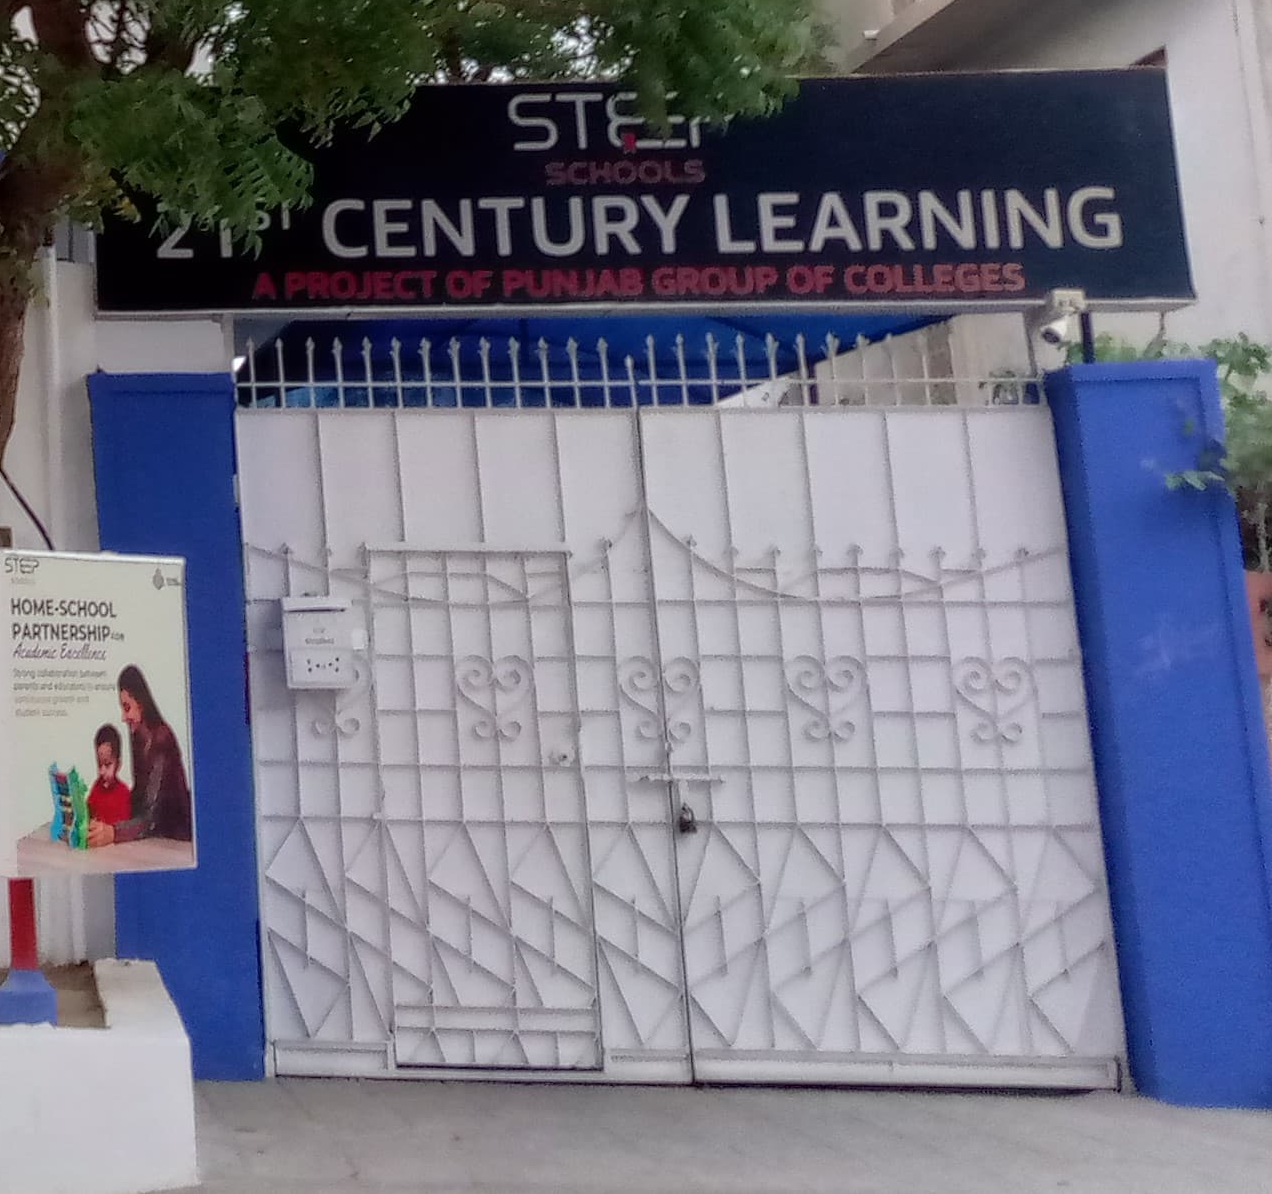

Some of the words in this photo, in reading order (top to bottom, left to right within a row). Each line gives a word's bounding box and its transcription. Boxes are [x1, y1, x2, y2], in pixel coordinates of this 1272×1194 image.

[544, 159, 706, 186] SCHOOLS
[323, 195, 690, 258] CENTURY
[713, 187, 1124, 255] LEARNING
[251, 272, 277, 300] A
[285, 270, 437, 300] PROJECT
[445, 269, 493, 299] OF
[503, 266, 645, 297] PUNJAB
[652, 265, 779, 295] GROUP
[785, 264, 836, 294] OF
[844, 262, 1025, 295] COLLEGES
[4, 557, 40, 574] STEP
[10, 597, 118, 619] HOME-SCHOOL
[11, 622, 111, 642] PARTNERSHIP
[12, 643, 58, 660] Academic
[59, 642, 108, 661] Excellence
